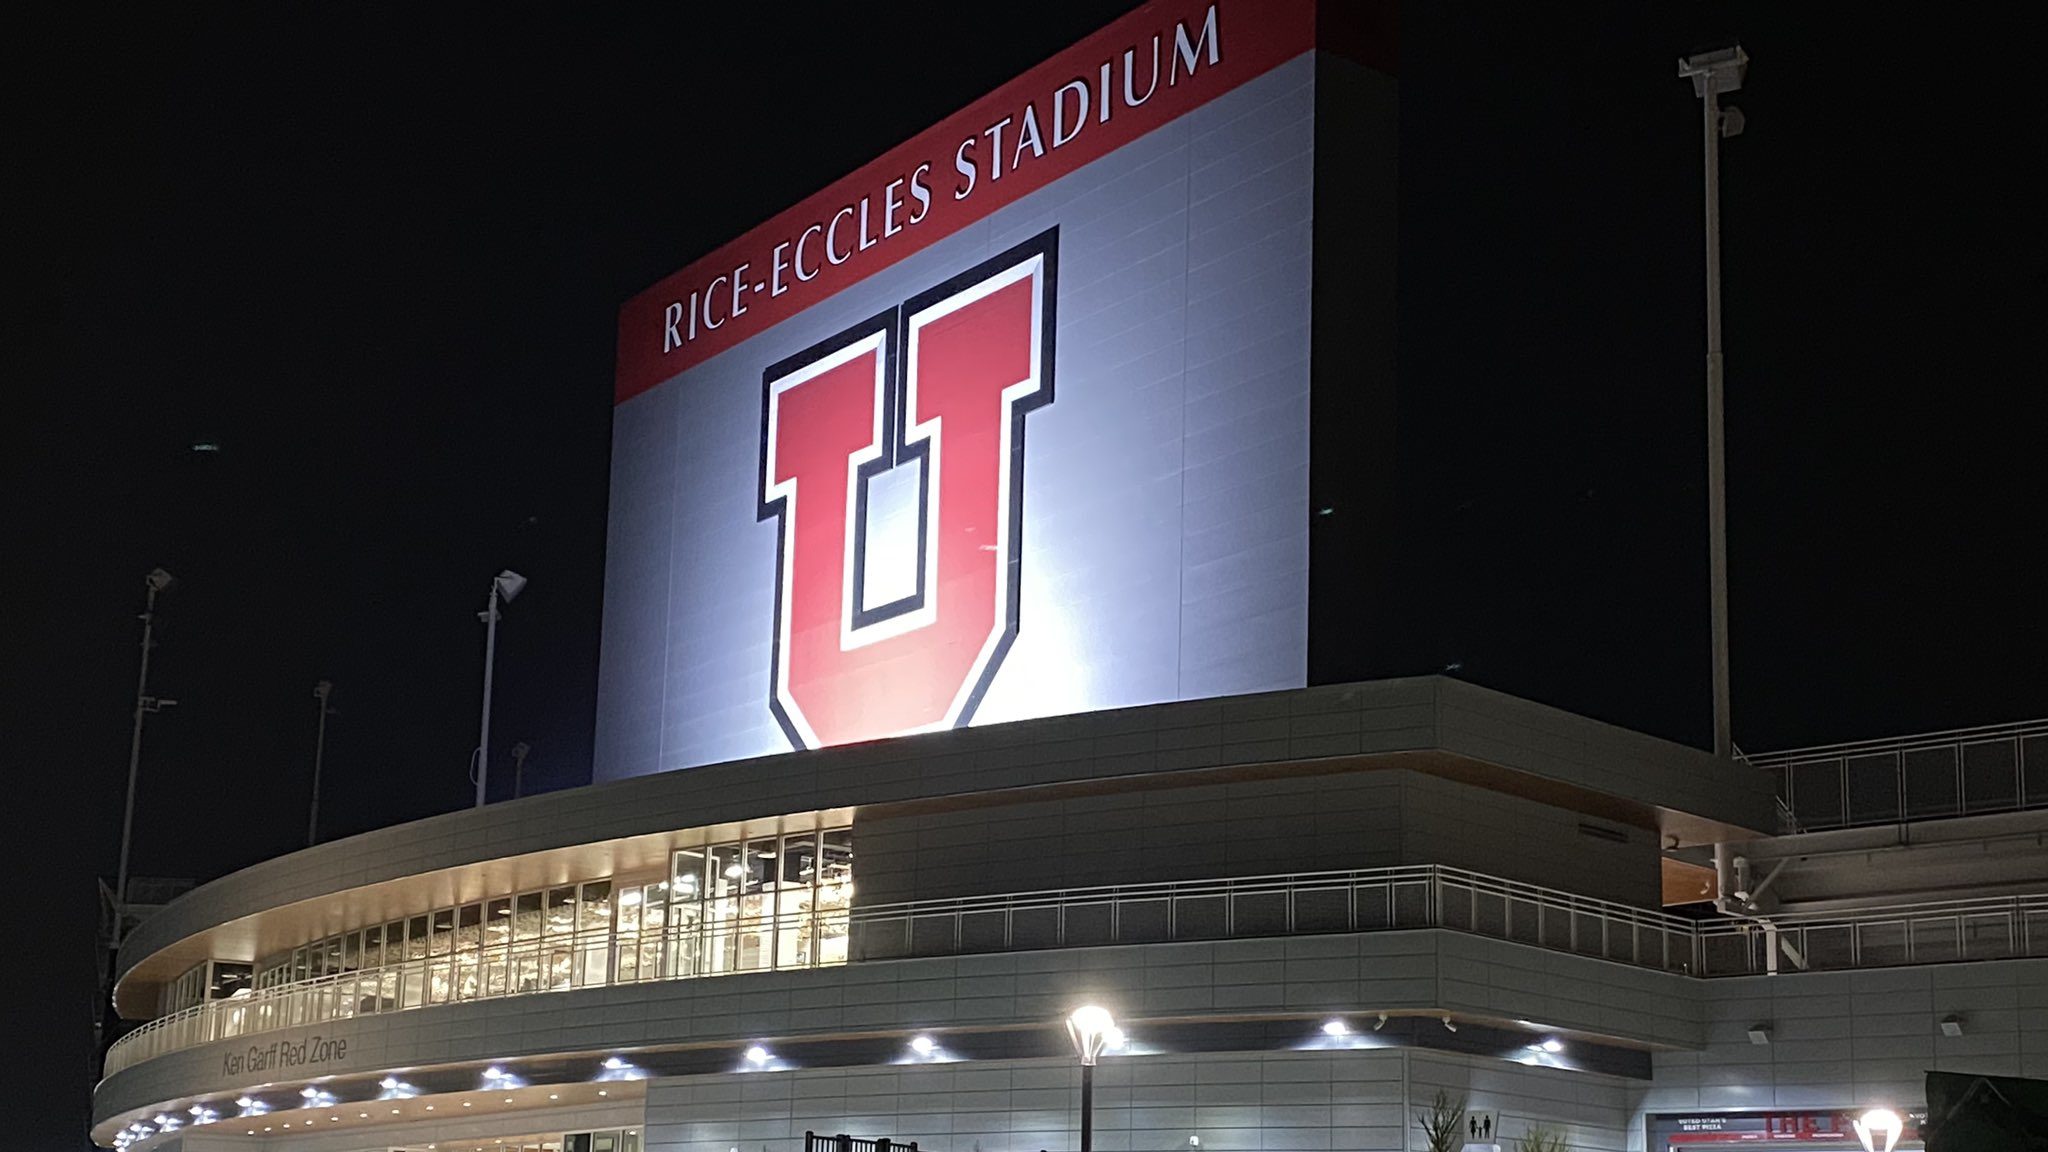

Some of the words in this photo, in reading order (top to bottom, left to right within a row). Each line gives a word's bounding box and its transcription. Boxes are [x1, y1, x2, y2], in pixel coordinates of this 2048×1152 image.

[663, 163, 933, 353] RICE-ECCLES
[953, 5, 1222, 201] STADIUM
[757, 224, 1060, 752] U
[223, 1052, 244, 1076] Ken
[247, 1043, 278, 1072] Garff
[280, 1037, 307, 1067] Red
[309, 1036, 347, 1063] Zone
